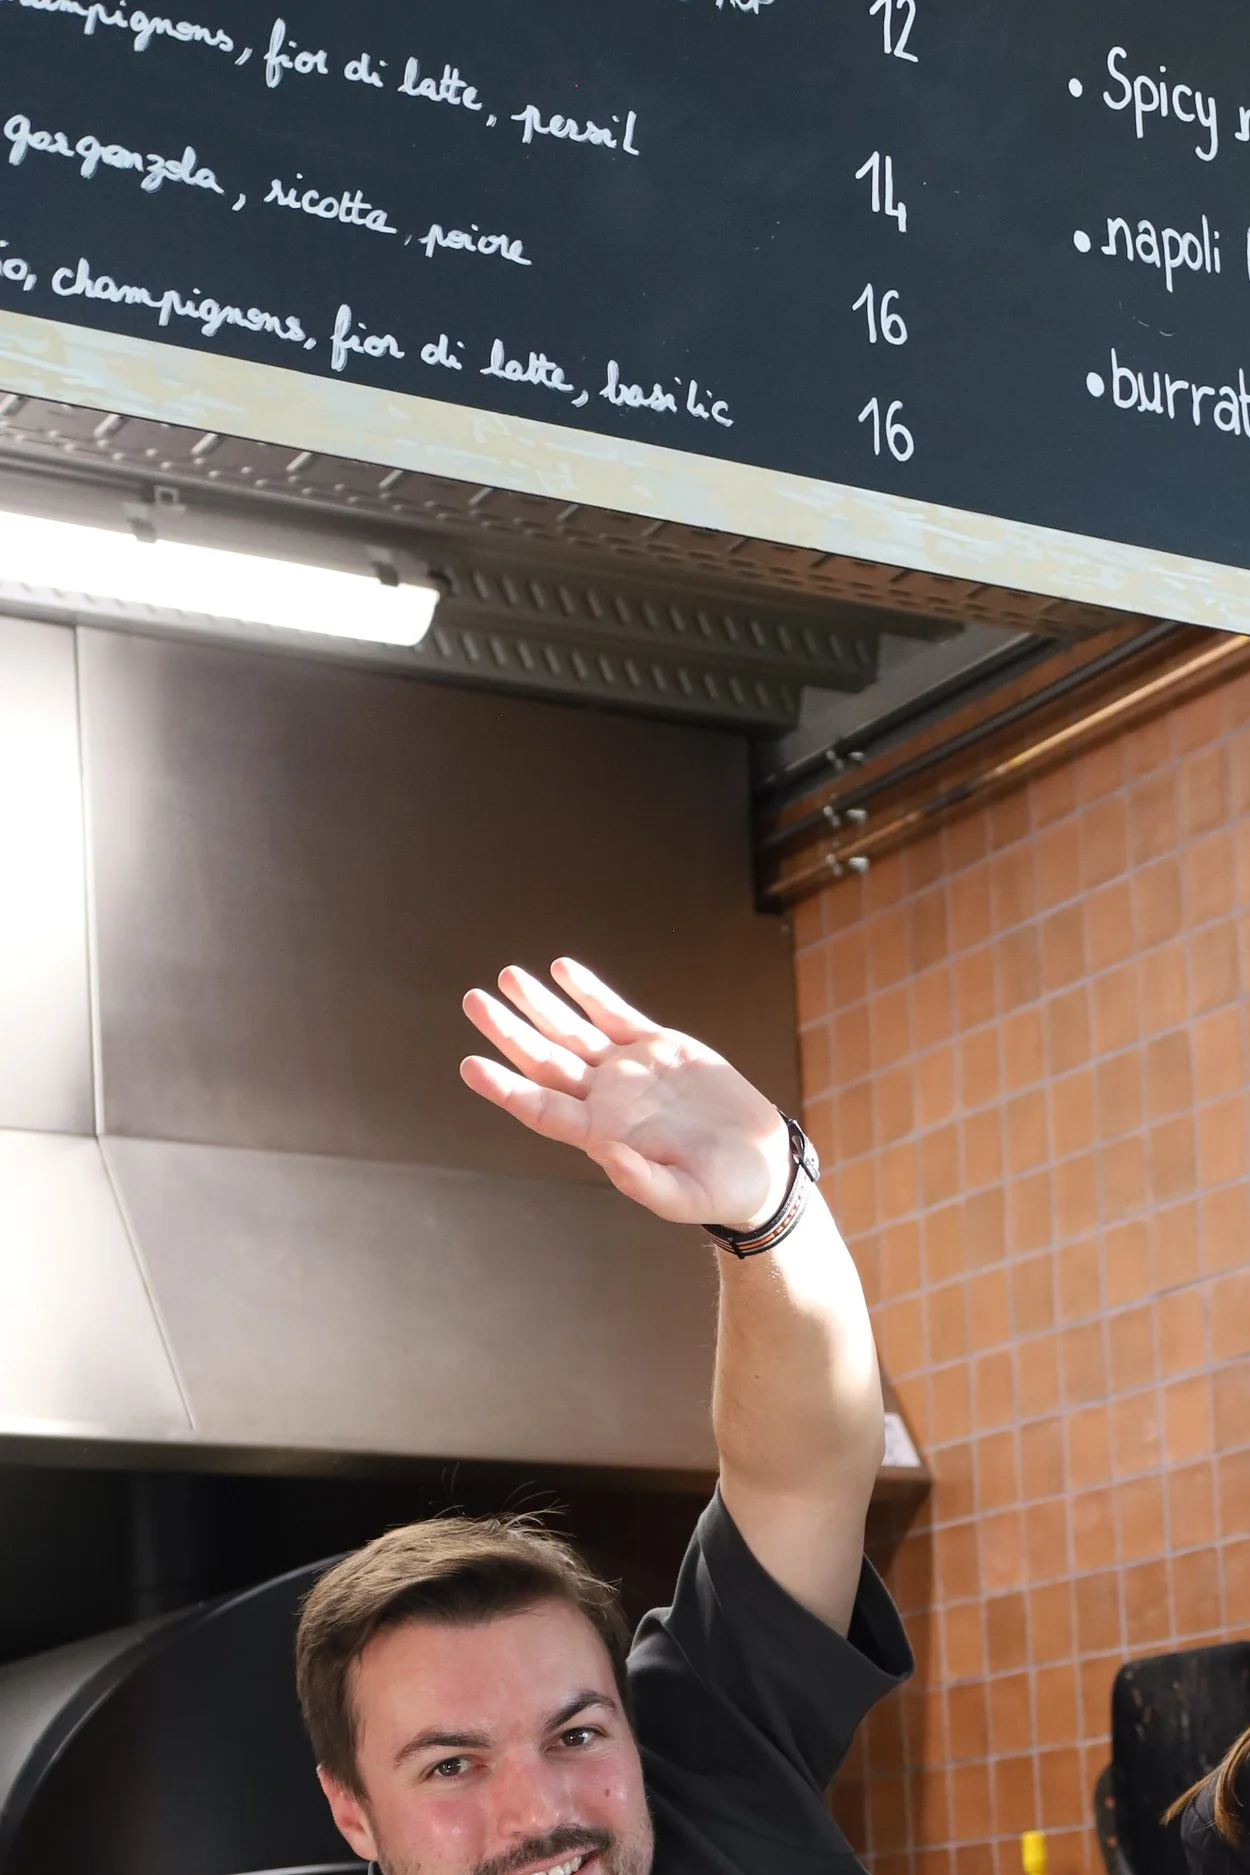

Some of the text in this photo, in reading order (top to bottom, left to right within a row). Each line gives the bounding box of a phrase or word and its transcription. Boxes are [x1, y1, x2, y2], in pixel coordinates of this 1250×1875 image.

[869, 0, 919, 63] 12
[8, 0, 640, 156] mpignons, fior di latte, persil
[1102, 46, 1219, 162] Spicy
[263, 173, 411, 246] ricotta,
[855, 150, 907, 233] 14
[1100, 214, 1221, 293] napoli
[51, 257, 317, 350] champignons,
[329, 304, 405, 372] fior
[420, 333, 464, 370] di
[479, 338, 589, 408] latte,
[598, 359, 734, 428] basilic
[851, 282, 908, 346] 16
[857, 397, 915, 462] 16
